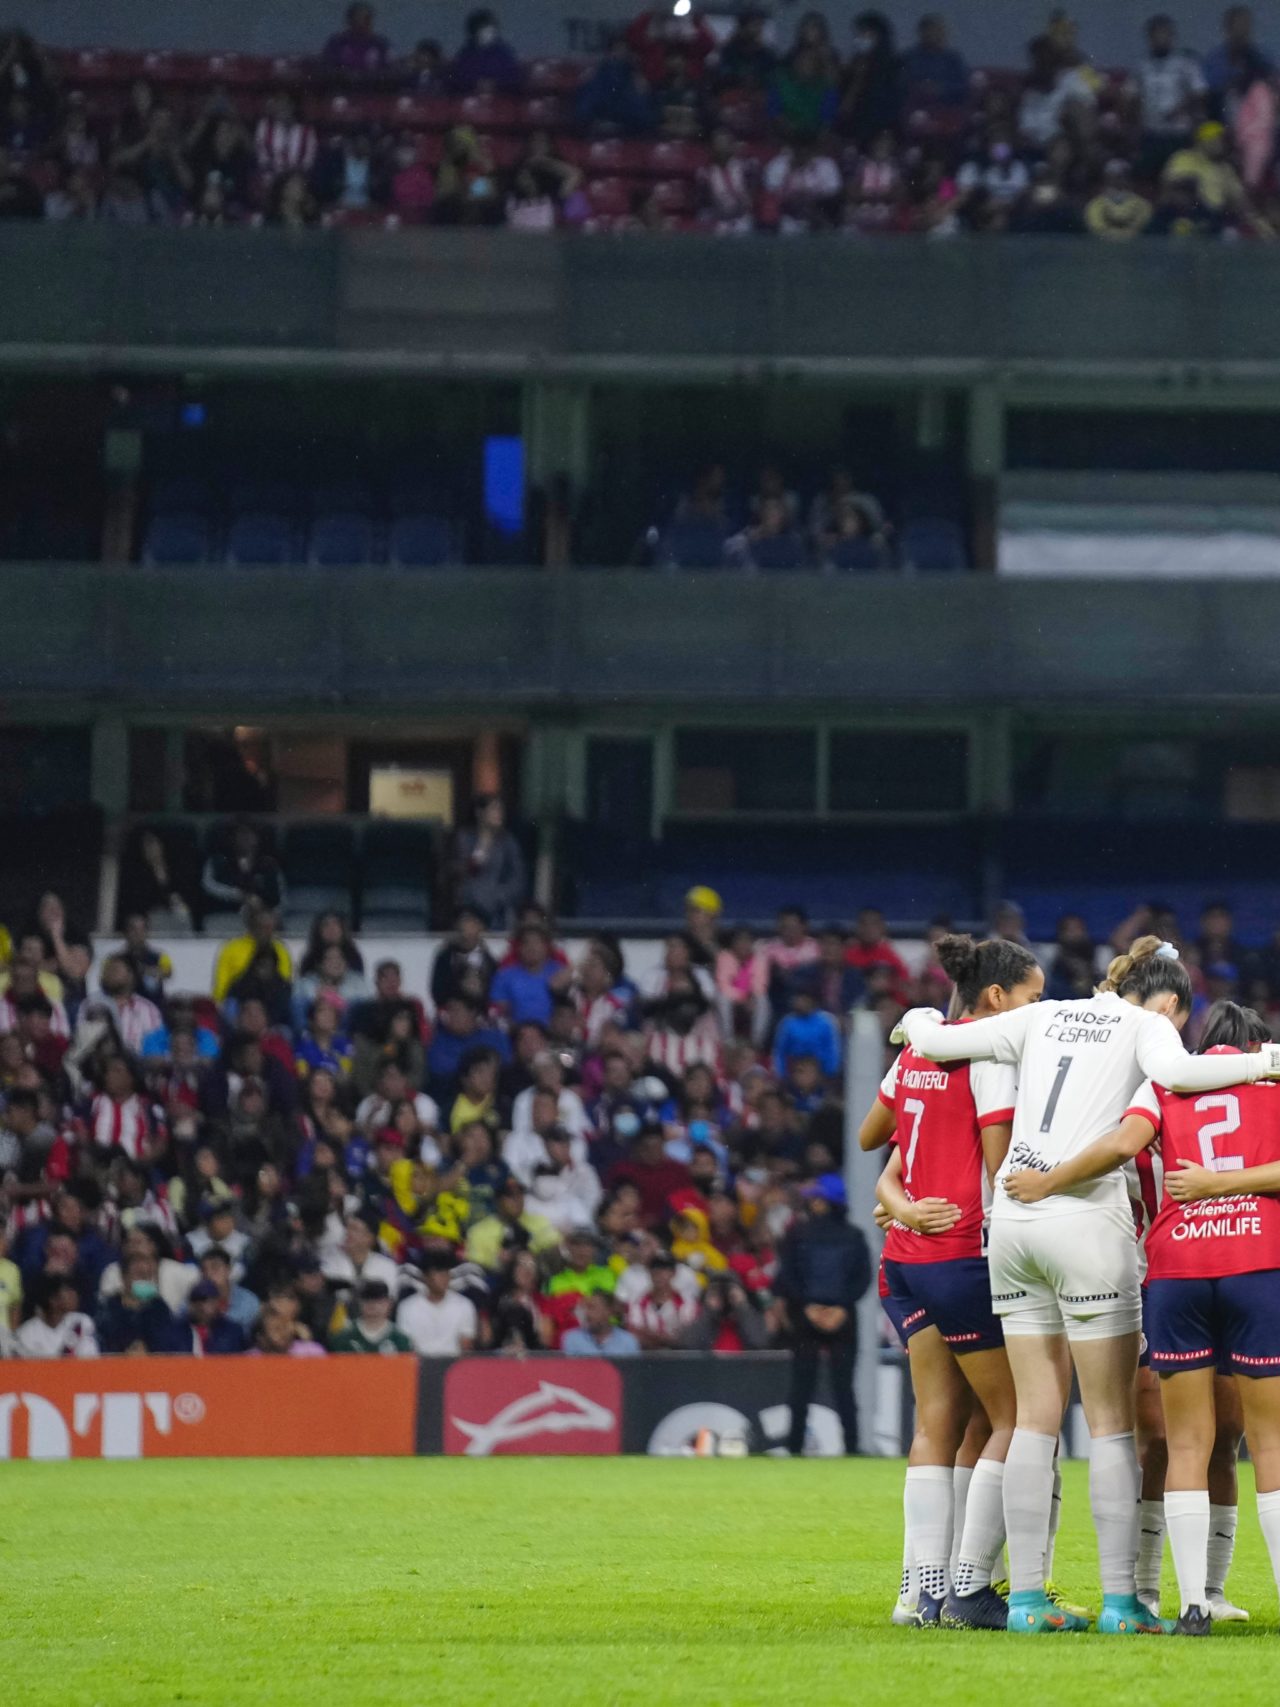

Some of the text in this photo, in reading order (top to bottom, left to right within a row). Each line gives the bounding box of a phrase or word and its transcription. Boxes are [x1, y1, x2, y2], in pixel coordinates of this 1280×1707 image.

[1058, 1027, 1111, 1043] ESPINO
[902, 1069, 949, 1090] MONTERO
[1040, 1055, 1073, 1133] 1
[903, 1098, 925, 1183] 7
[1195, 1093, 1245, 1173] 2
[1184, 1202, 1257, 1220] caliente.mx
[1172, 1217, 1261, 1240] OMNILIFE
[1153, 1349, 1208, 1360] GUADALAJARA
